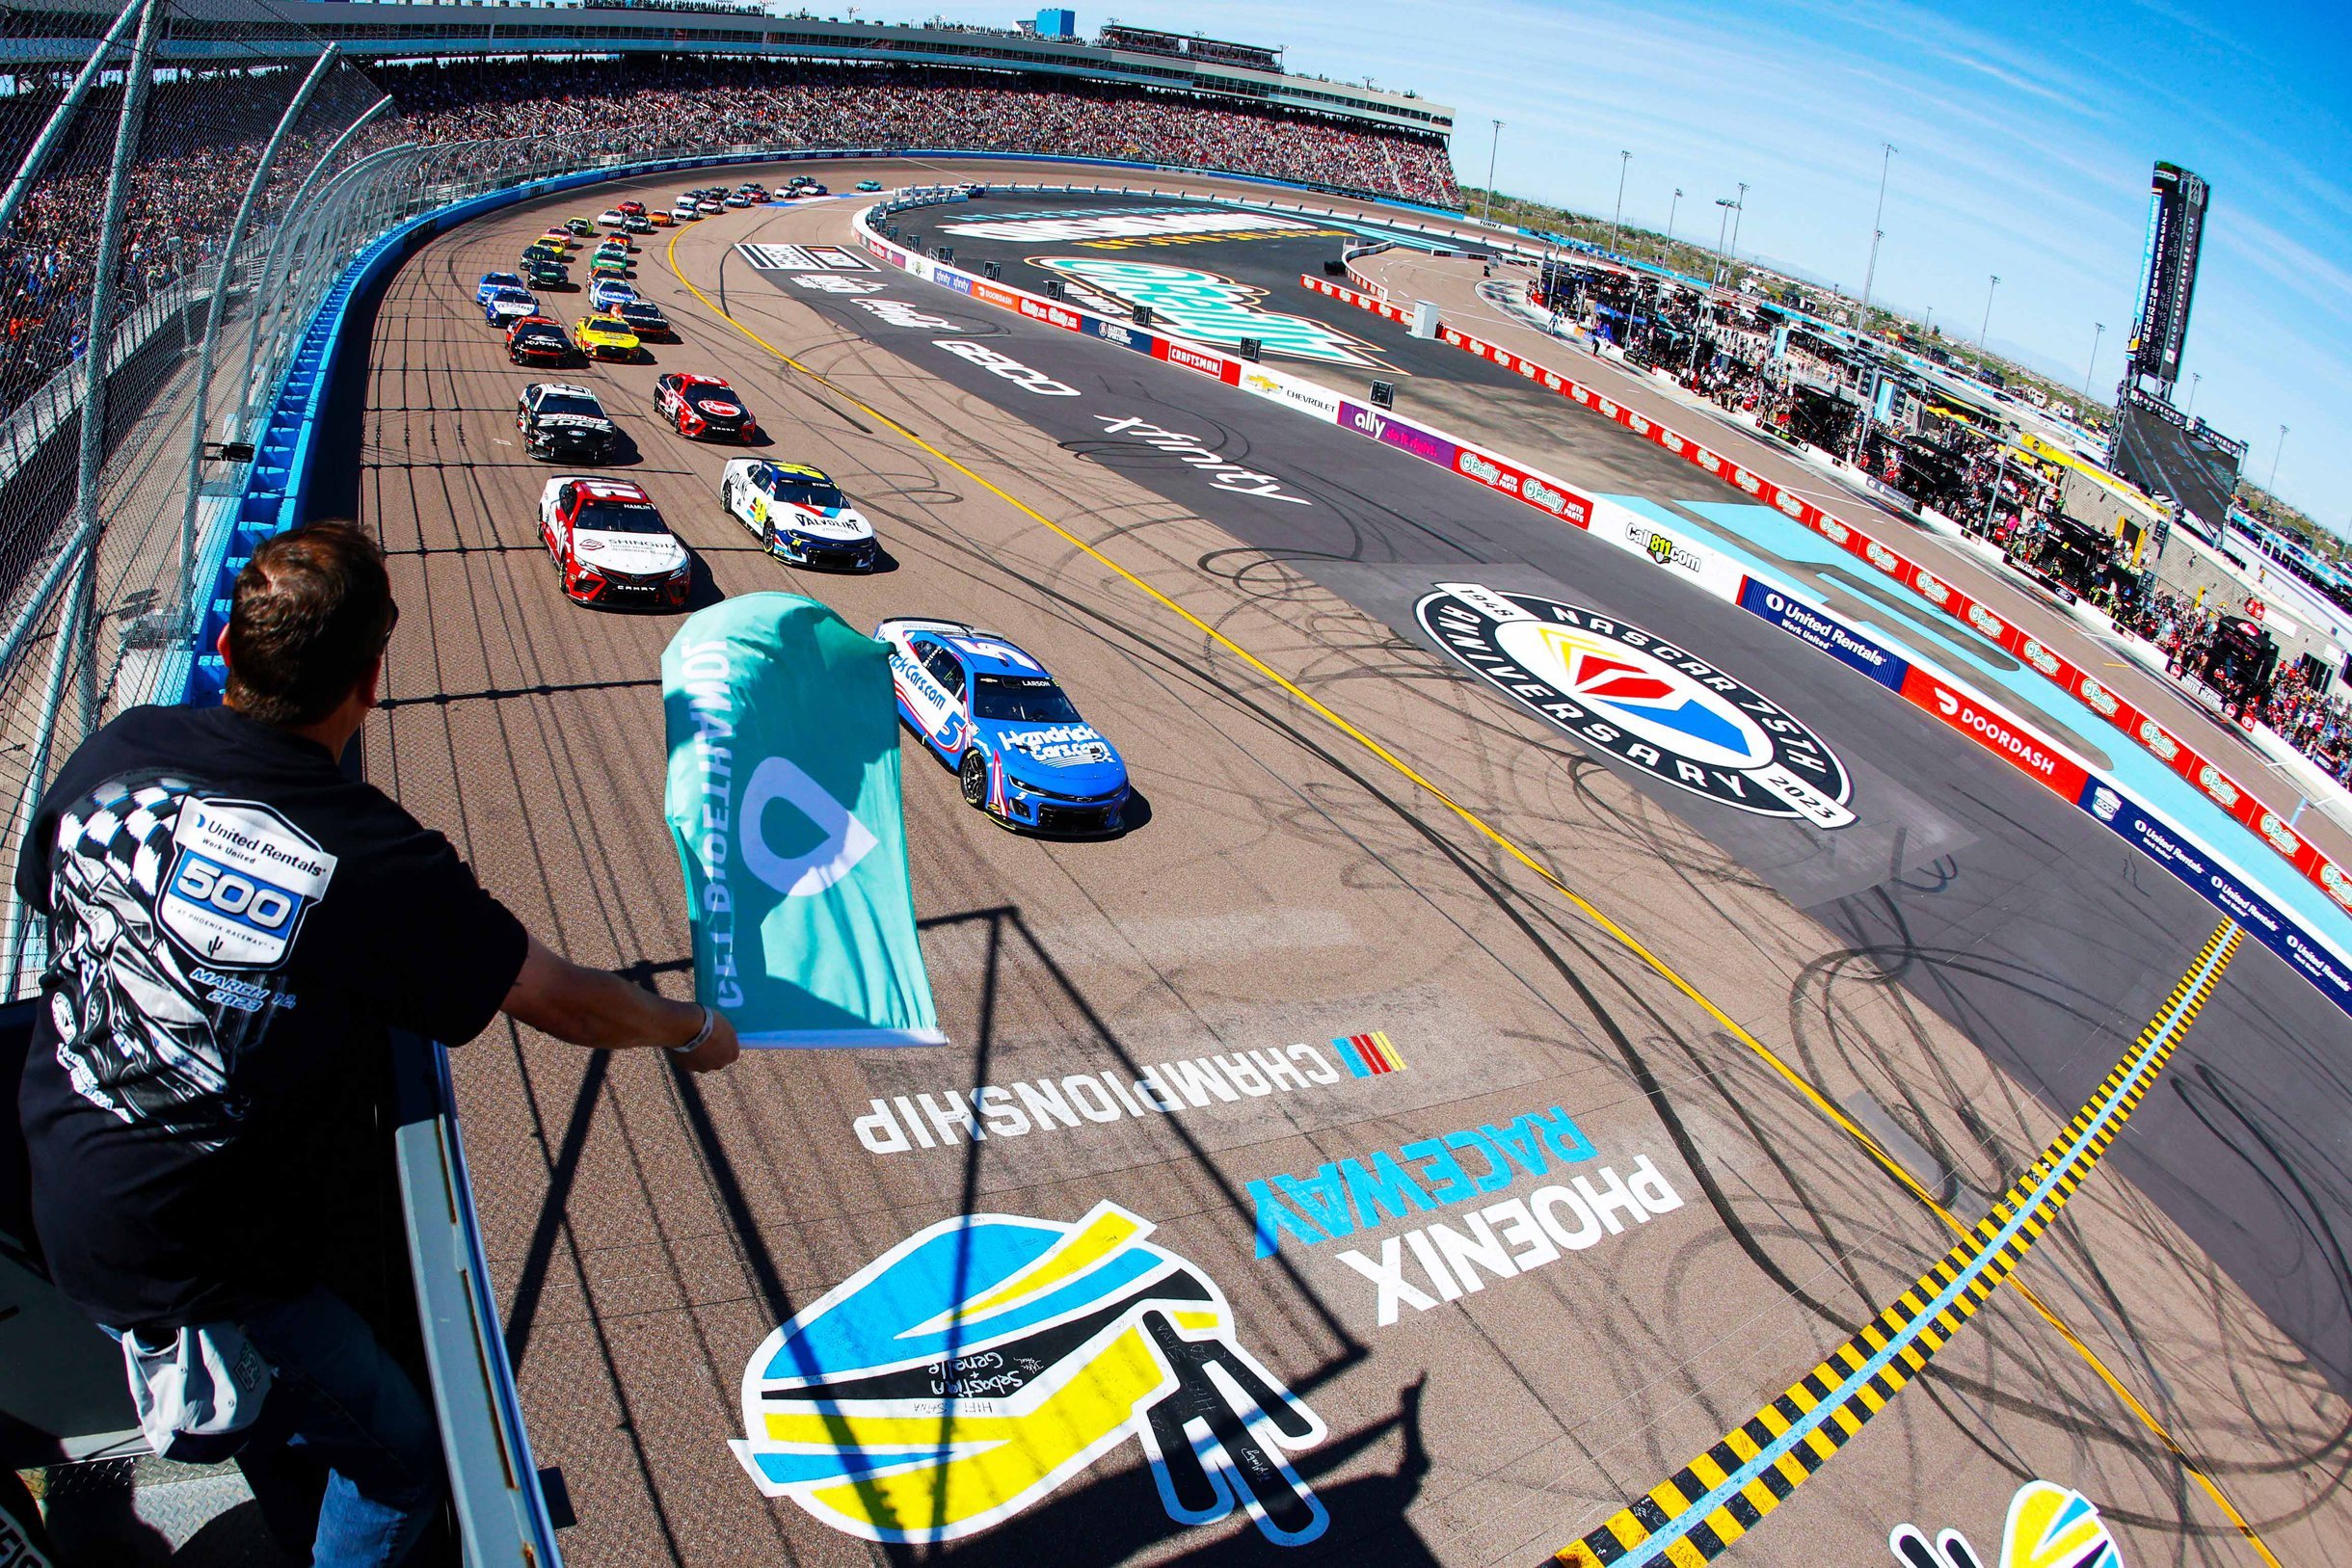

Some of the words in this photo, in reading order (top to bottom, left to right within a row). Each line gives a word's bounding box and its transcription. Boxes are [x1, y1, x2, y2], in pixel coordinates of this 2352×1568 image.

[1479, 220, 1496, 228] TURN
[2161, 217, 2167, 226] 2
[2161, 226, 2165, 234] 3
[2158, 243, 2163, 252] 5
[2154, 270, 2159, 279] 8
[2155, 261, 2161, 270] 7
[953, 277, 969, 293] xfinity
[985, 289, 1012, 305] DOORDASH
[2151, 287, 2158, 297] 10
[2147, 306, 2155, 316] 12
[2149, 297, 2156, 306] 11
[2144, 323, 2152, 333] 14
[2146, 315, 2153, 325] 13
[2142, 332, 2151, 343] 15
[932, 340, 1082, 396] GEICO
[1286, 389, 1337, 413] CHEVROLET
[538, 418, 613, 433] EDGE
[1355, 411, 1386, 439] ally
[1093, 414, 1312, 506] xfinity
[1459, 451, 1500, 486] O'Reilly
[1498, 479, 1519, 493] PARTS
[1501, 472, 1518, 486] AUTO
[1522, 478, 1565, 515] O'Reilly
[1567, 501, 1585, 515] AUTO
[794, 513, 862, 533] VALVOLINE
[1564, 509, 1585, 524] PARTS
[608, 538, 677, 551] SHINGRIX
[1625, 522, 1701, 573] Call811.com
[1866, 542, 1898, 571] O'Reilly
[1916, 571, 1950, 603] O'Reilly
[1459, 589, 1514, 617] 1948
[1781, 619, 1801, 636] Work
[1803, 630, 1830, 651] United
[1785, 603, 1831, 637] United
[1831, 628, 1884, 667] Rentals
[1968, 604, 2004, 638] O'Reilly
[2024, 640, 2061, 675] O'Reilly
[1438, 604, 1748, 798] ANNIVERSARY
[1553, 606, 1737, 692] NASCAR
[1739, 700, 1829, 774] 75TH
[2081, 678, 2119, 716] O'Reilly
[936, 710, 965, 746] 5
[998, 725, 1099, 752] Hendrick
[1961, 707, 2055, 776] DOORDASH
[2140, 720, 2179, 760] O'Reilly
[1030, 741, 1109, 761] Cars.com
[1771, 775, 1836, 820] 2023
[2200, 765, 2240, 807] O'Reilly
[2096, 798, 2114, 813] 500
[207, 819, 260, 850] United
[260, 843, 323, 877] Rentals
[2260, 812, 2300, 855] O'Reilly
[201, 837, 224, 852] Work
[225, 846, 256, 865] United
[2146, 828, 2175, 852] United
[2173, 848, 2202, 874] Rentals
[177, 858, 292, 929] 500
[2221, 885, 2250, 909] United
[2248, 905, 2277, 931] Rentals
[188, 912, 224, 932] PHOENIX
[226, 927, 262, 946] RACEWAY
[2297, 944, 2325, 970] United
[2321, 965, 2350, 992] Rentals
[189, 968, 271, 1000] MARCH
[206, 989, 264, 1012] 2023
[852, 1043, 1340, 1155] CHAMPIONSHIP
[1244, 1104, 1598, 1260] RACEWAY
[1335, 1154, 1685, 1327] PHOENIX
[927, 1351, 1003, 1380] Genelle
[930, 1370, 1024, 1398] Sebastian
